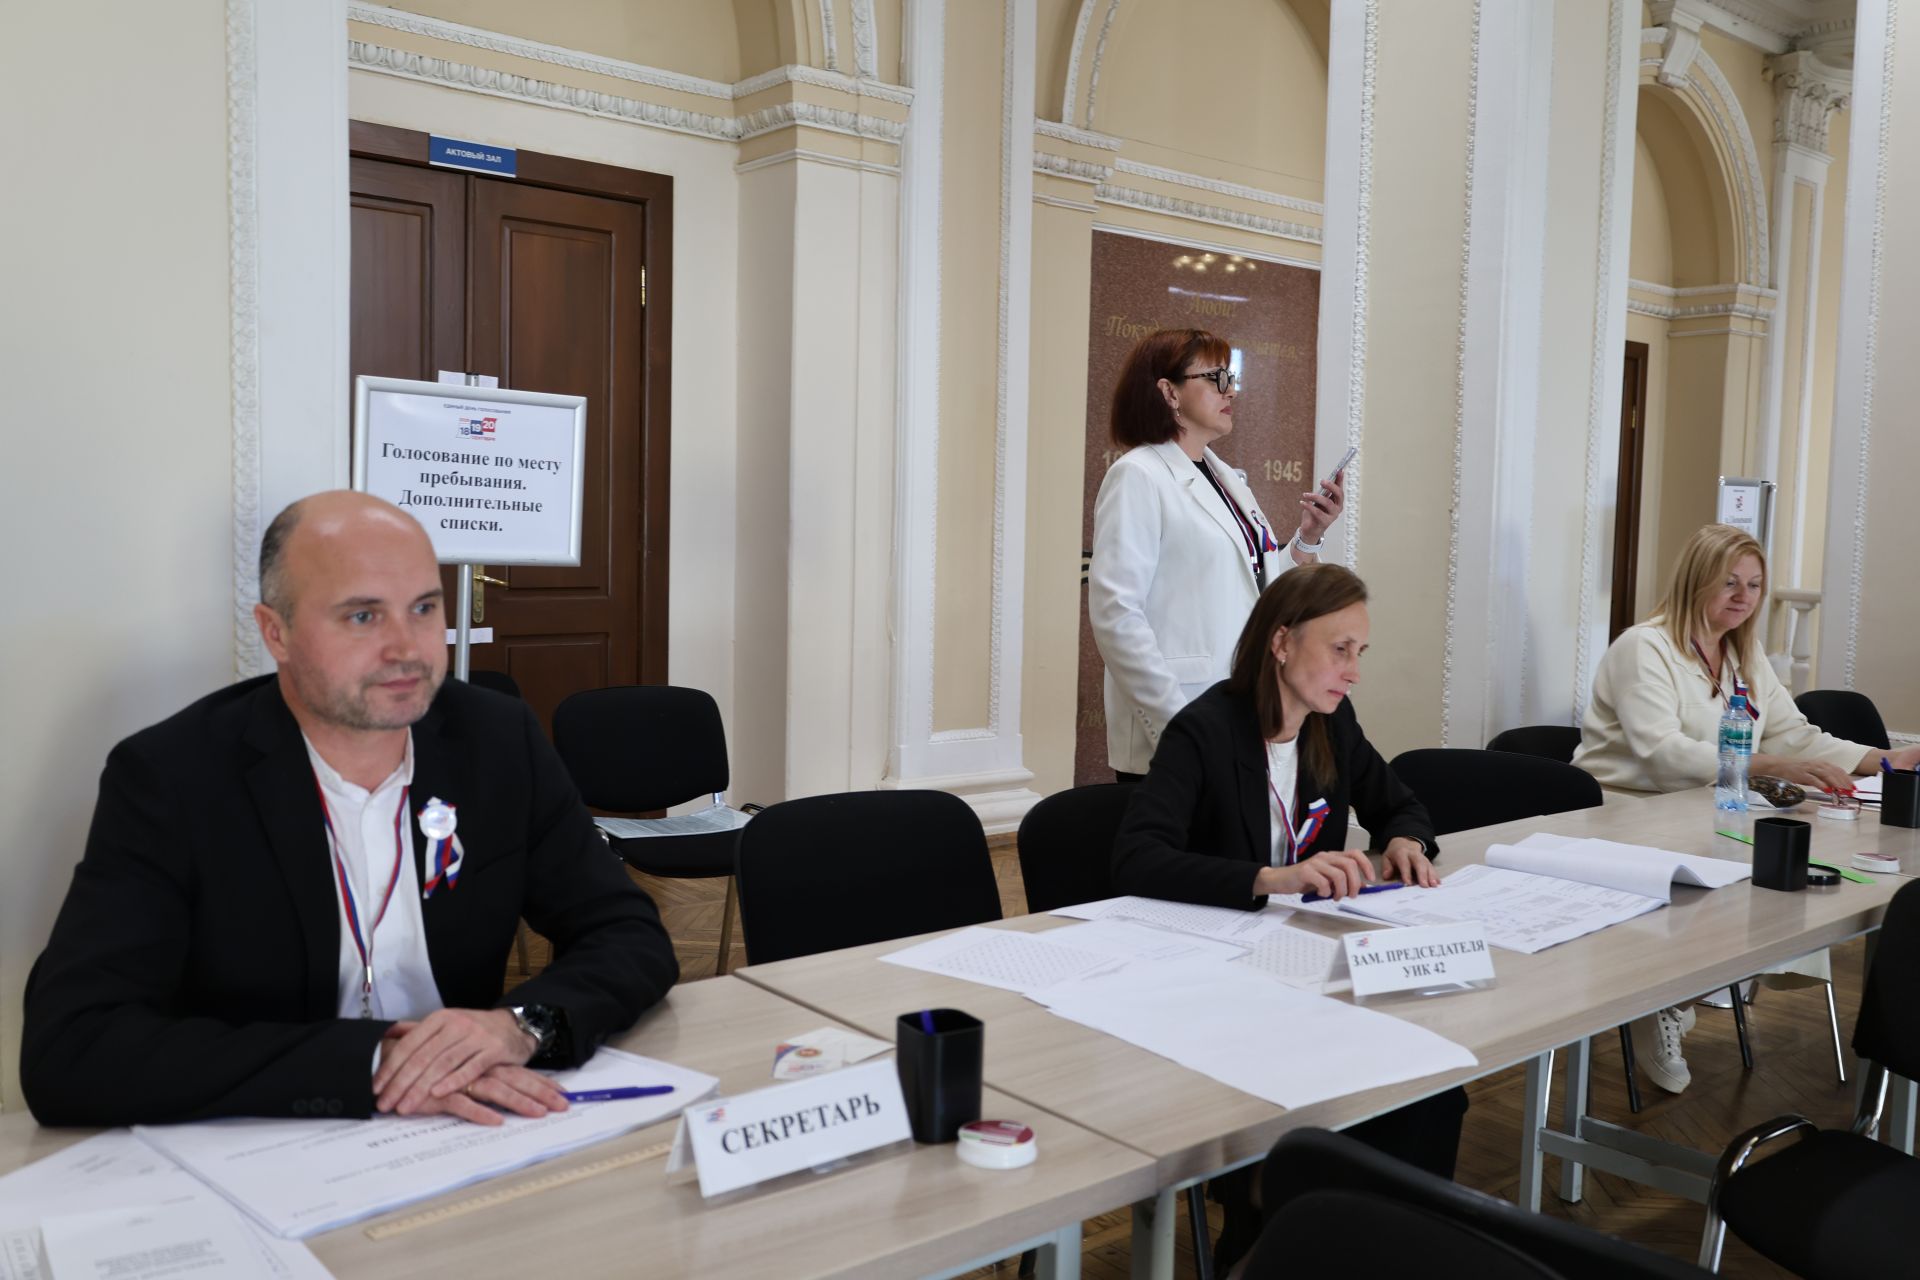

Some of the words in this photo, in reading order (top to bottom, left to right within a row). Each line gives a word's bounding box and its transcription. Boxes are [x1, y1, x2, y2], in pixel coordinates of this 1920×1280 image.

[445, 147, 485, 160] АКТОВЫЙ
[486, 154, 502, 163] ЗАЛ
[460, 427, 470, 436] 18
[472, 423, 482, 432] 19
[482, 420, 495, 430] 20
[381, 442, 490, 466] Голосование
[494, 456, 513, 467] по
[518, 457, 562, 475] месту
[419, 471, 527, 490] пребывания.
[1263, 459, 1303, 482] 1945
[398, 489, 543, 513] Дополнительные
[440, 517, 503, 532] списки.
[1352, 953, 1385, 967] ЗАМ.
[1386, 939, 1485, 963] ПРЕДСЕДАТЕЛЯ
[1402, 962, 1432, 978] УИК
[1433, 961, 1447, 974] 42
[720, 1093, 881, 1155] СЕКРЕТАРЬ
